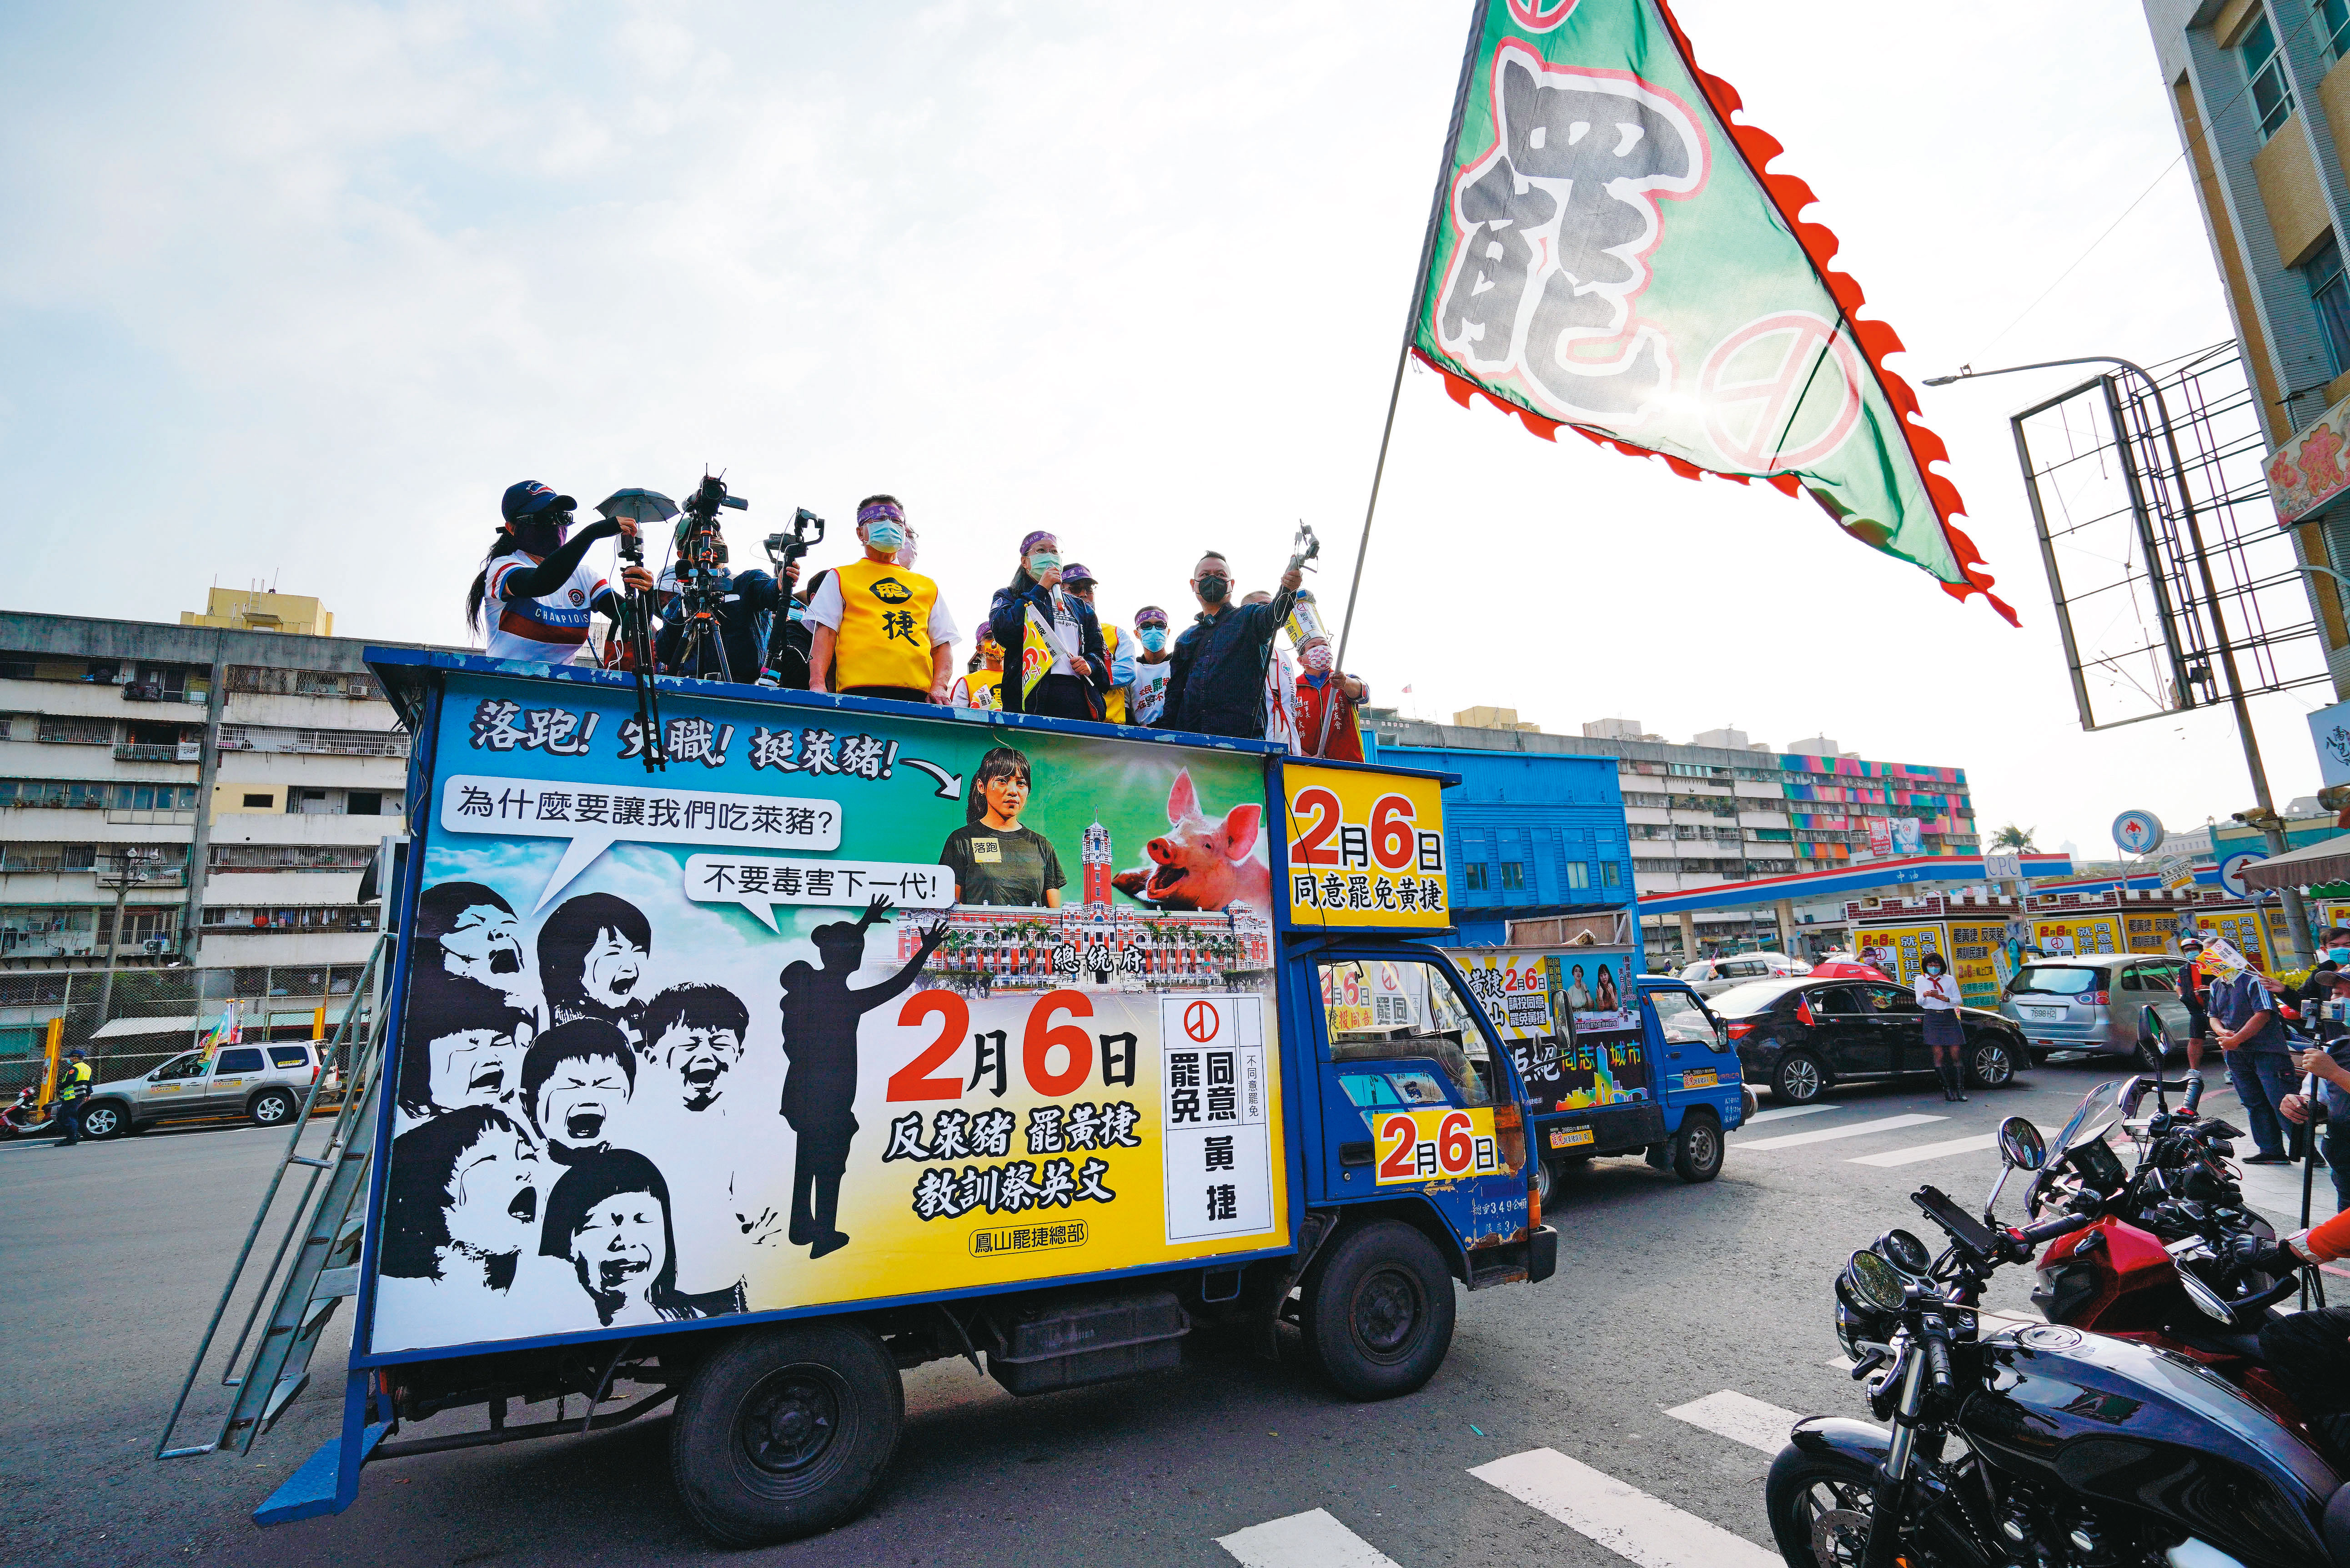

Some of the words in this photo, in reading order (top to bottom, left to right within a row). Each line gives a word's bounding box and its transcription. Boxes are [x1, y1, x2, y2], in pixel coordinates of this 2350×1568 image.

[1437, 45, 1701, 423] 罷
[882, 610, 920, 647] 捷
[1303, 700, 1311, 719] 理事長
[469, 699, 600, 757] 落跑!
[748, 725, 899, 781] 挺萊豬!
[457, 785, 833, 837] 為什麼要讓我們吃萊豬?
[973, 839, 999, 855] 落跑
[1290, 786, 1445, 875] 2月6日
[703, 863, 937, 900] 不要毒害下一代!
[1896, 869, 1918, 882] 中油
[1987, 857, 2018, 876] CPC
[1293, 873, 1446, 913] 同意罷免黃捷
[1863, 934, 1895, 946] 2月6日
[1953, 928, 1978, 944] 罷黃捷
[1981, 927, 2005, 942] 反萊豬
[2040, 925, 2072, 937] 2月6日
[2129, 919, 2152, 933] 罷黃捷
[2238, 916, 2261, 953] 同意罷免
[1051, 944, 1145, 974] 總統府
[1956, 946, 1989, 960] 教訓民進黨
[1320, 971, 1370, 1006] 2月6日
[1460, 967, 1506, 1000] 黃捷
[1505, 968, 1546, 991] 2月6日
[1507, 994, 1545, 1011] 請投同意
[1509, 1010, 1547, 1027] 罷免黃捷
[2030, 1009, 2056, 1018] 7698-H2
[886, 989, 1138, 1103] 2月6日
[1610, 1040, 1641, 1067] 城市
[1170, 1053, 1201, 1124] 罷免
[1207, 1051, 1237, 1121] 同意
[1245, 1055, 1260, 1118] 不同意罷免
[882, 1106, 1015, 1163] 反萊豬
[1026, 1100, 1142, 1155] 罷黃捷
[1379, 1111, 1496, 1181] 2月6日
[913, 1157, 1117, 1222] 教訓蔡英文
[974, 1223, 1085, 1255] 鳳山罷捷總部
